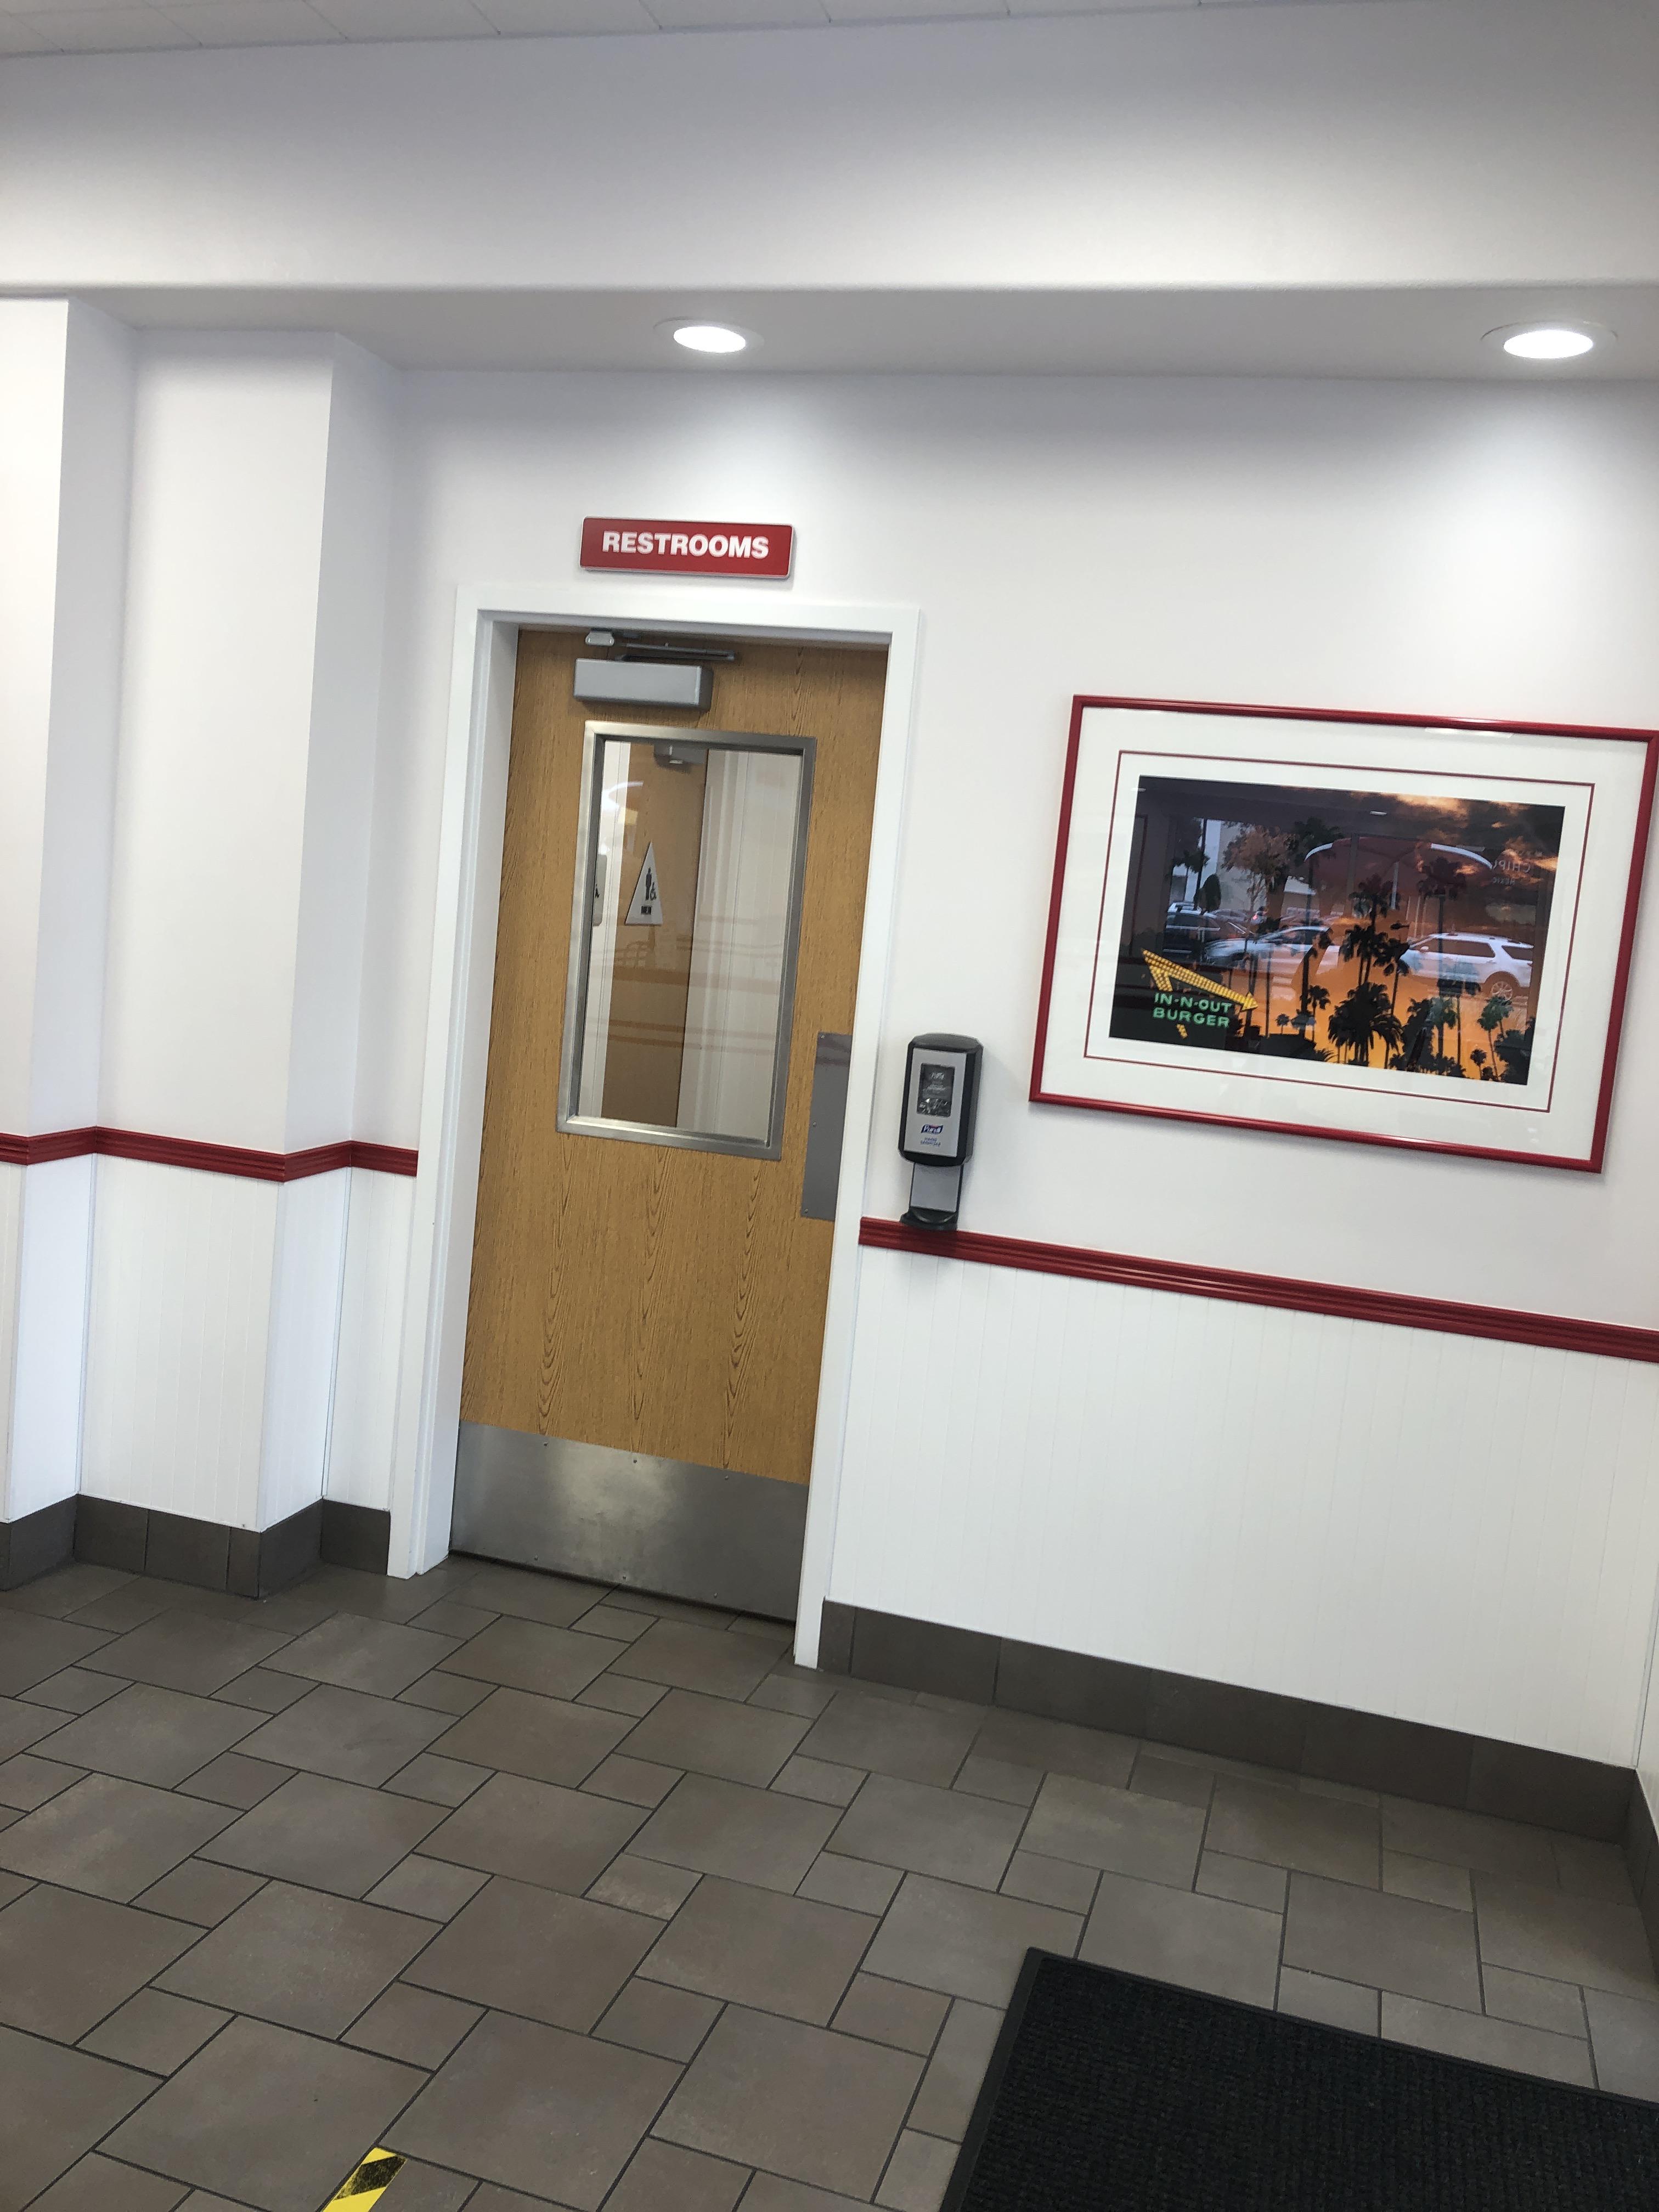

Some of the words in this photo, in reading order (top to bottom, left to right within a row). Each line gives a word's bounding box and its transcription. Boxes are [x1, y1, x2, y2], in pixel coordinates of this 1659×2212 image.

[602, 531, 769, 559] RESTROOMS
[1154, 992, 1232, 1014] IN-N-OUT
[1153, 1007, 1230, 1028] BURGER
